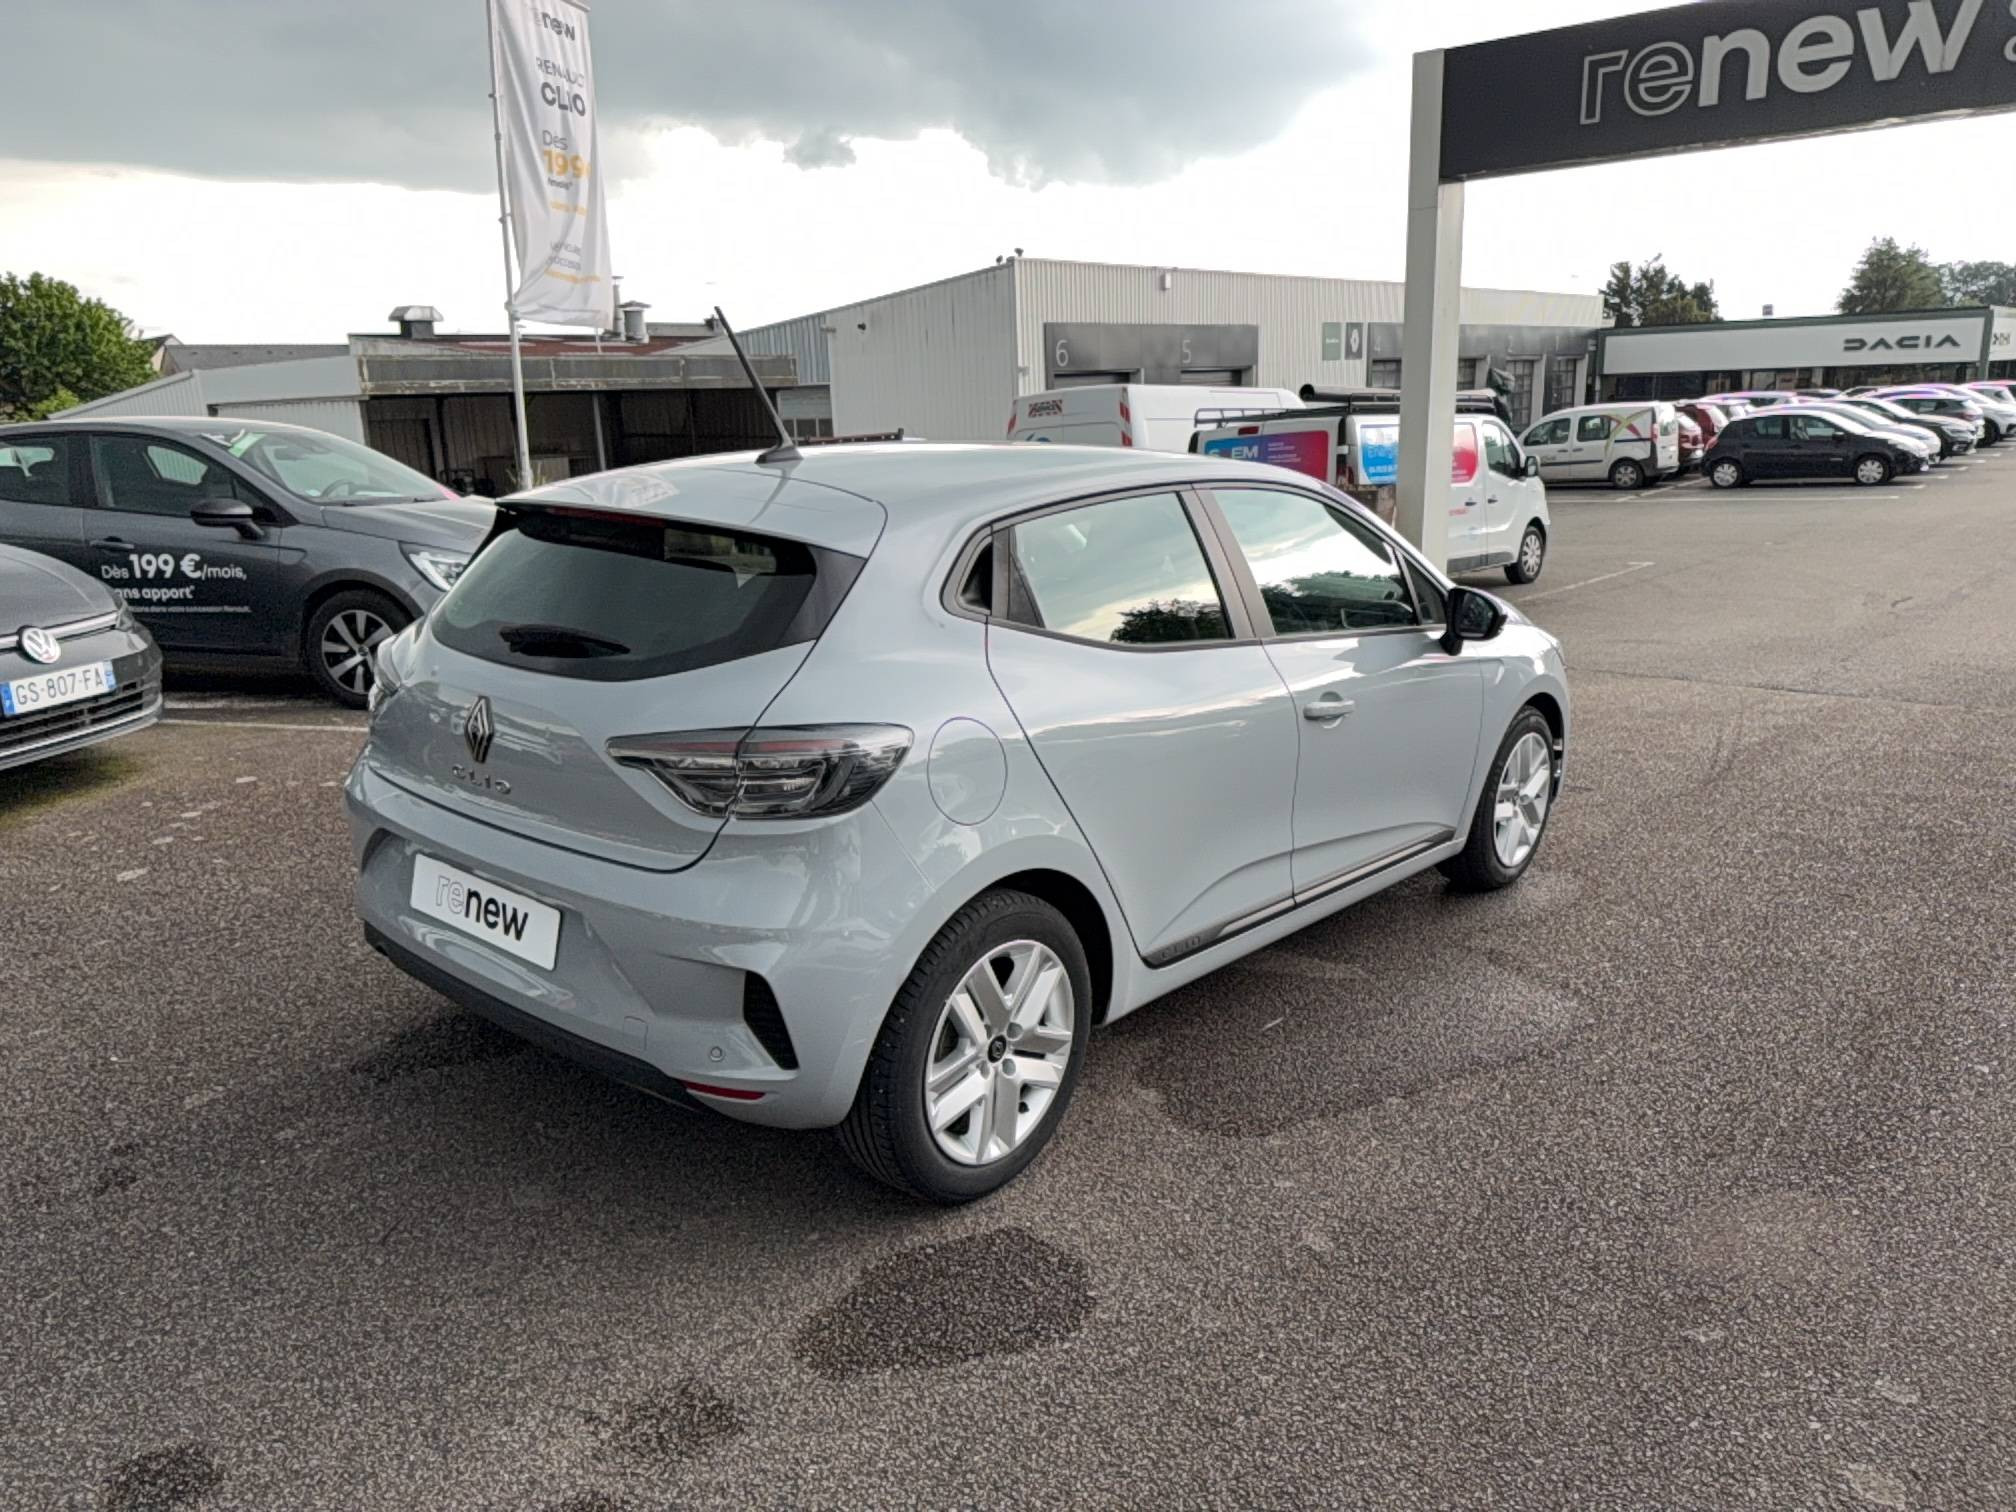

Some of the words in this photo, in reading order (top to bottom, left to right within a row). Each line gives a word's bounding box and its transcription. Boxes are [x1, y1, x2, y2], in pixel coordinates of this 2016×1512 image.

[1579, 0, 1984, 126] renew
[540, 81, 586, 117] CLIO
[1055, 339, 1069, 367] 6
[1182, 339, 1192, 364] 5
[1843, 334, 1961, 352] DACIA
[101, 563, 129, 579] Dès
[129, 553, 175, 579] 199
[110, 586, 140, 599] ans
[15, 667, 104, 705] GS-807-FA
[452, 764, 512, 796] CLIO
[435, 875, 529, 941] renew
